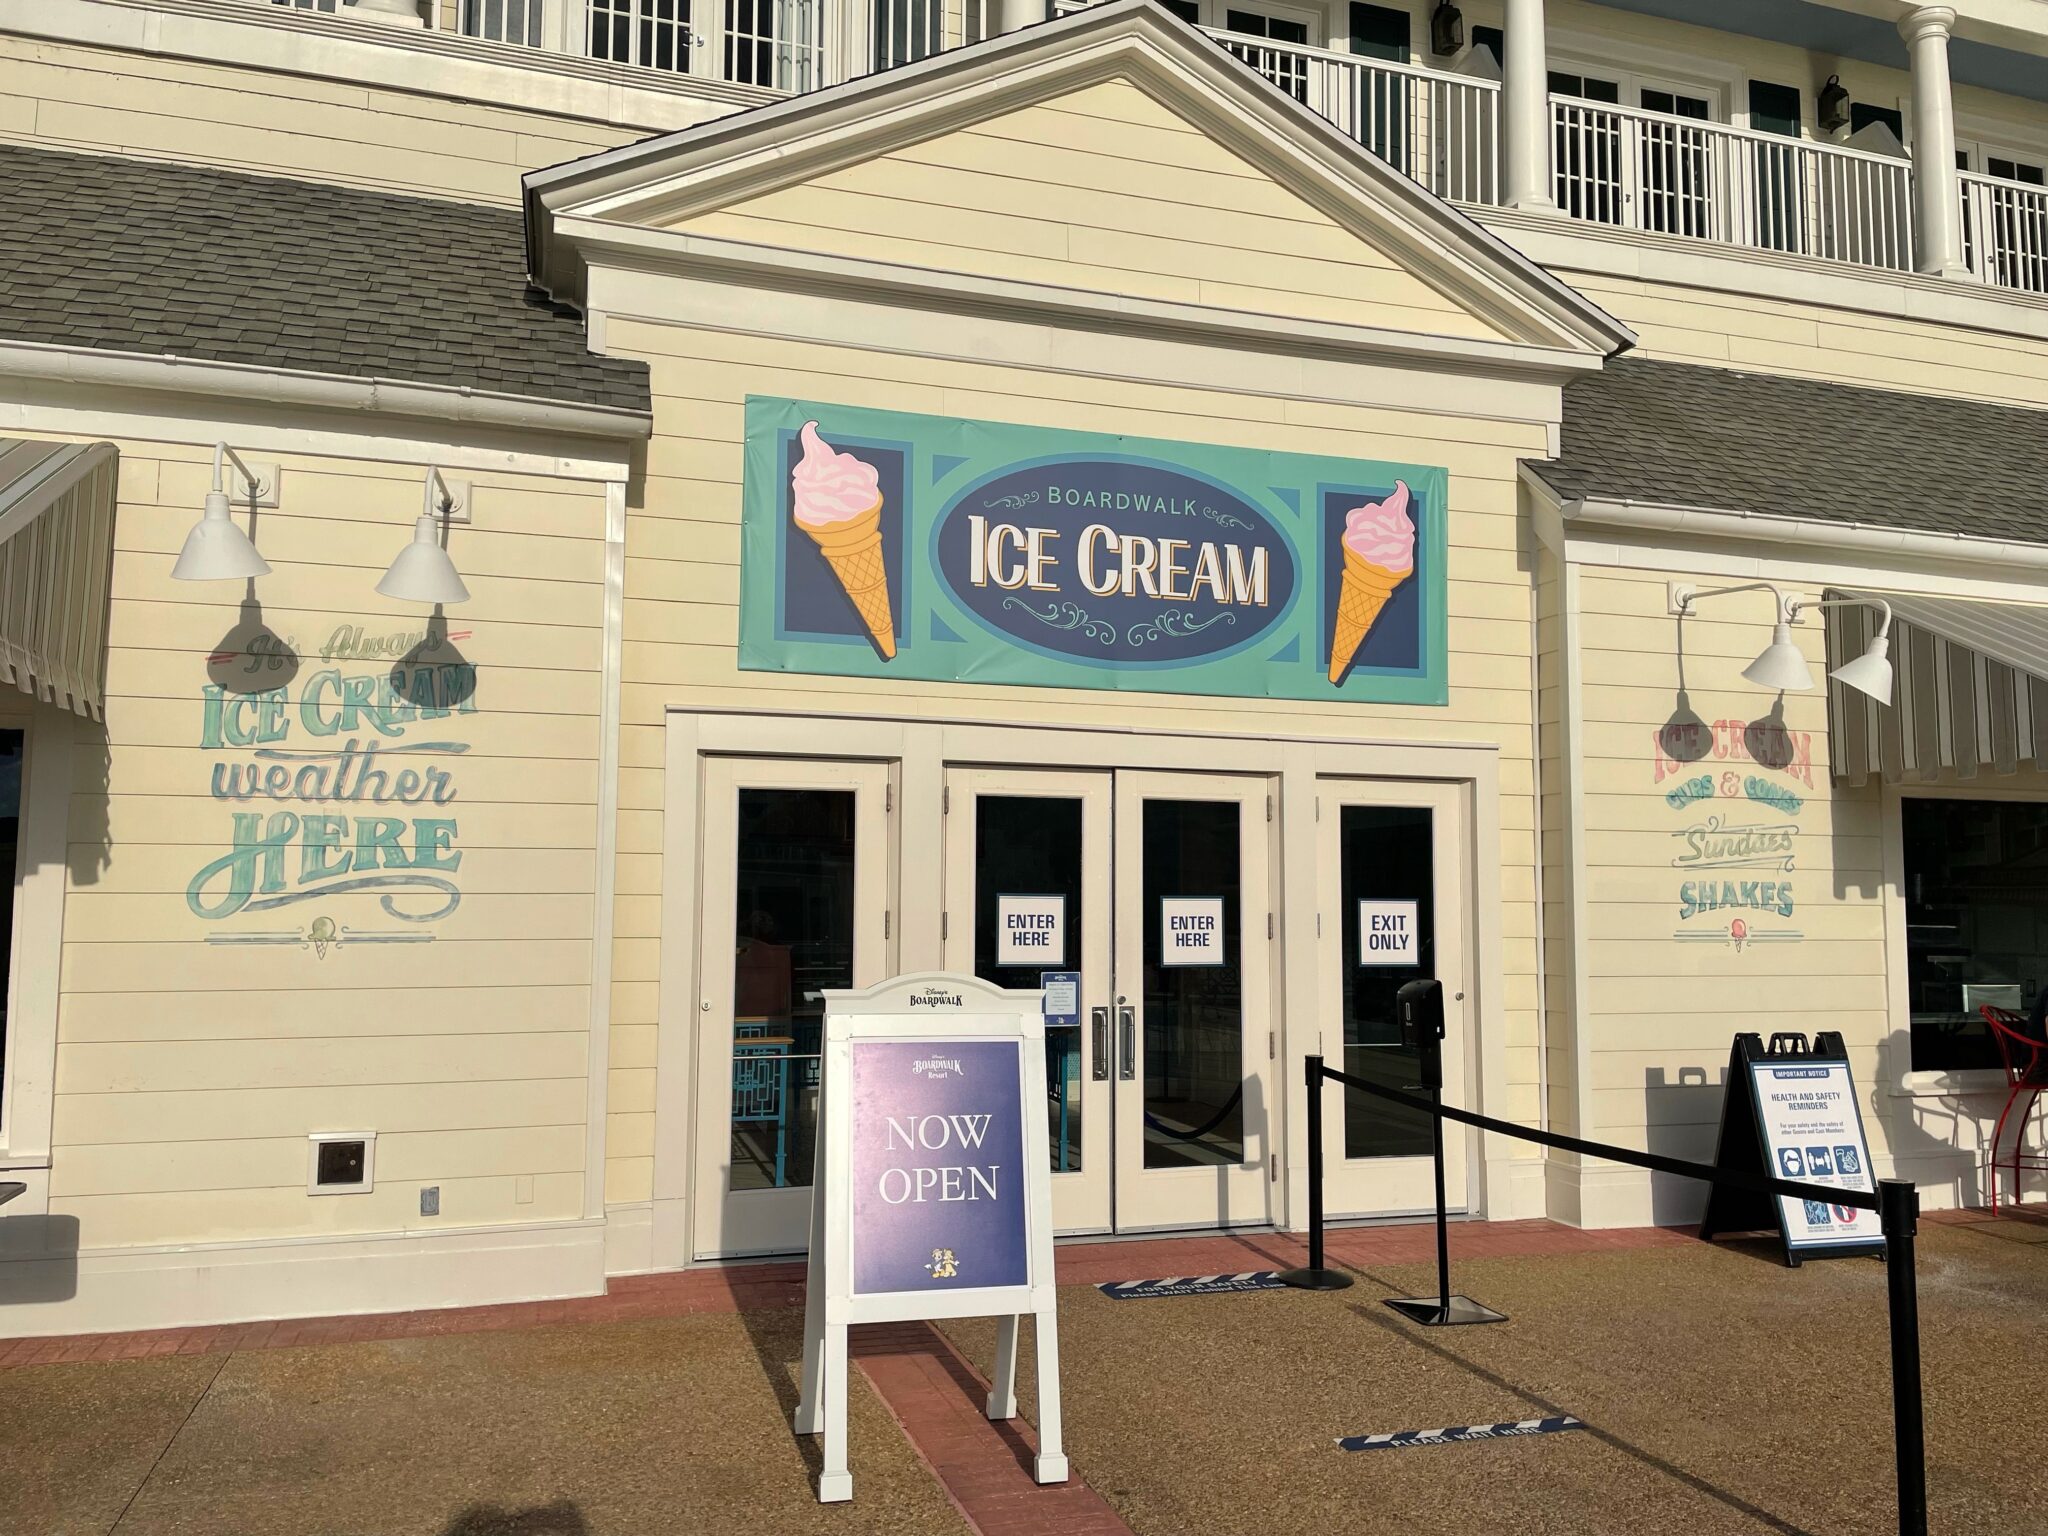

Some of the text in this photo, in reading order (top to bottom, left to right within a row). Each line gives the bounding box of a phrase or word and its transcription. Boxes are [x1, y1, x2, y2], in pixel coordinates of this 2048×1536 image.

[1047, 486, 1198, 516] BOARDWALK
[968, 514, 1269, 607] ICE CREAM
[244, 624, 443, 674] It's Always
[201, 662, 479, 750] ICE CREAM
[1653, 719, 1814, 790] ICE CREAM
[211, 738, 457, 806] weather
[1666, 775, 1715, 810] CUPS
[1720, 771, 1741, 798] &
[1679, 827, 1793, 861] Sundaes
[186, 810, 464, 920] HERE
[1679, 880, 1794, 920] SHAKES
[1007, 914, 1056, 930] ENTER
[1170, 915, 1215, 931] ENTER
[1371, 914, 1407, 932] EXIT
[1012, 931, 1050, 947] HERE
[1175, 932, 1211, 948] HERE
[1369, 933, 1410, 951] ONLY
[910, 994, 962, 1007] BOARDWALK
[912, 1059, 964, 1076] BOARDWALK
[1775, 1069, 1828, 1078] IMPORTANT NOTICE
[1771, 1091, 1840, 1102] HEALTH AND SAFETY
[1788, 1101, 1829, 1111] REMINDERS
[885, 1114, 993, 1151] NOW
[878, 1165, 1001, 1204] OPEN
[1121, 1290, 1159, 1299] Please
[1162, 1289, 1192, 1297] WAIT
[1196, 1286, 1233, 1294] Behind
[1136, 1279, 1257, 1293] FOR YOUR SAFETY
[1390, 1426, 1543, 1448] PLEASE WAIT HERE
